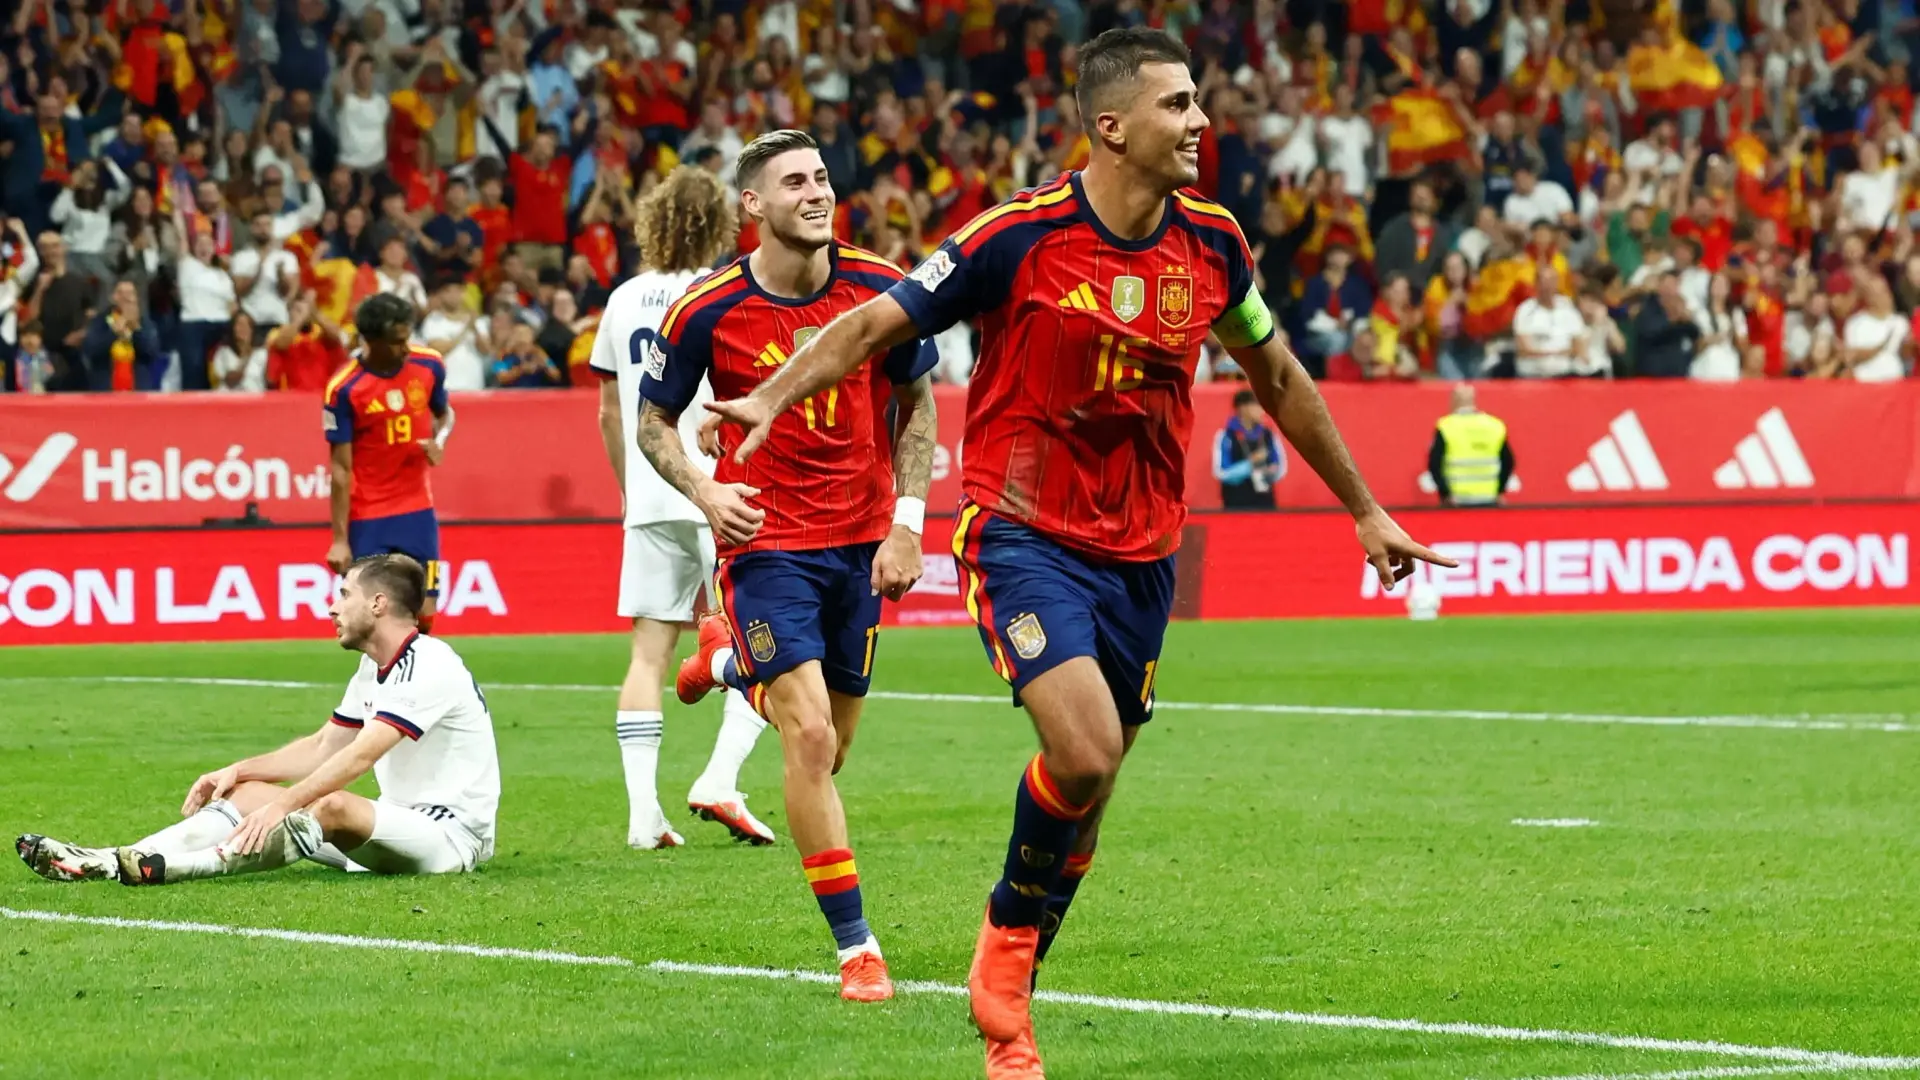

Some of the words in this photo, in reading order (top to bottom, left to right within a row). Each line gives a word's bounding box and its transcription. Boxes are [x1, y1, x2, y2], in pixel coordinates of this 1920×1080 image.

[1094, 334, 1149, 392] 16
[386, 414, 412, 445] 19
[82, 444, 291, 502] Halcón
[1752, 533, 1909, 592] CON
[0, 568, 135, 628] ON
[156, 565, 265, 624] LA
[280, 559, 508, 620] RA
